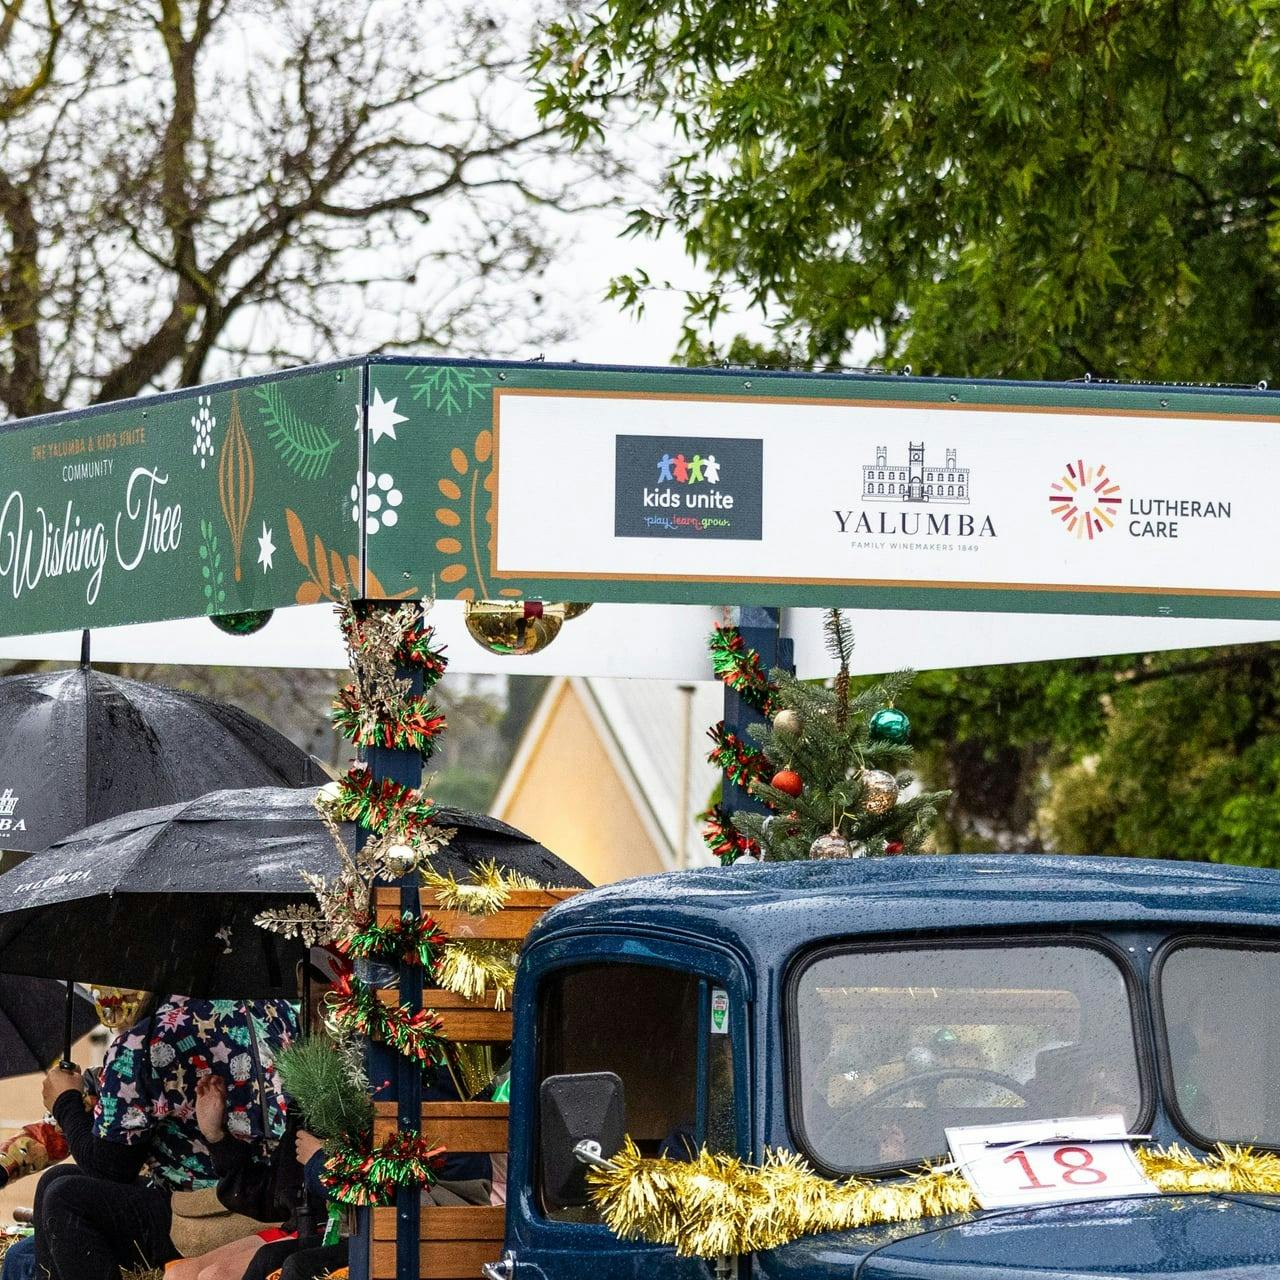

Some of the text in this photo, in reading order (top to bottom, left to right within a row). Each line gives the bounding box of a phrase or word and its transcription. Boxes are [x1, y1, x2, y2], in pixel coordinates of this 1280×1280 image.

[62, 459, 114, 482] COMMUNITY
[643, 487, 734, 509] kids unite
[1129, 498, 1232, 519] LUTHERAN
[115, 466, 182, 571] Tree
[832, 510, 998, 537] YALUMBA
[1128, 520, 1178, 538] CARE
[851, 541, 979, 552] FAMILY WINEMAKERS 1849
[1003, 1146, 1108, 1190] 18
